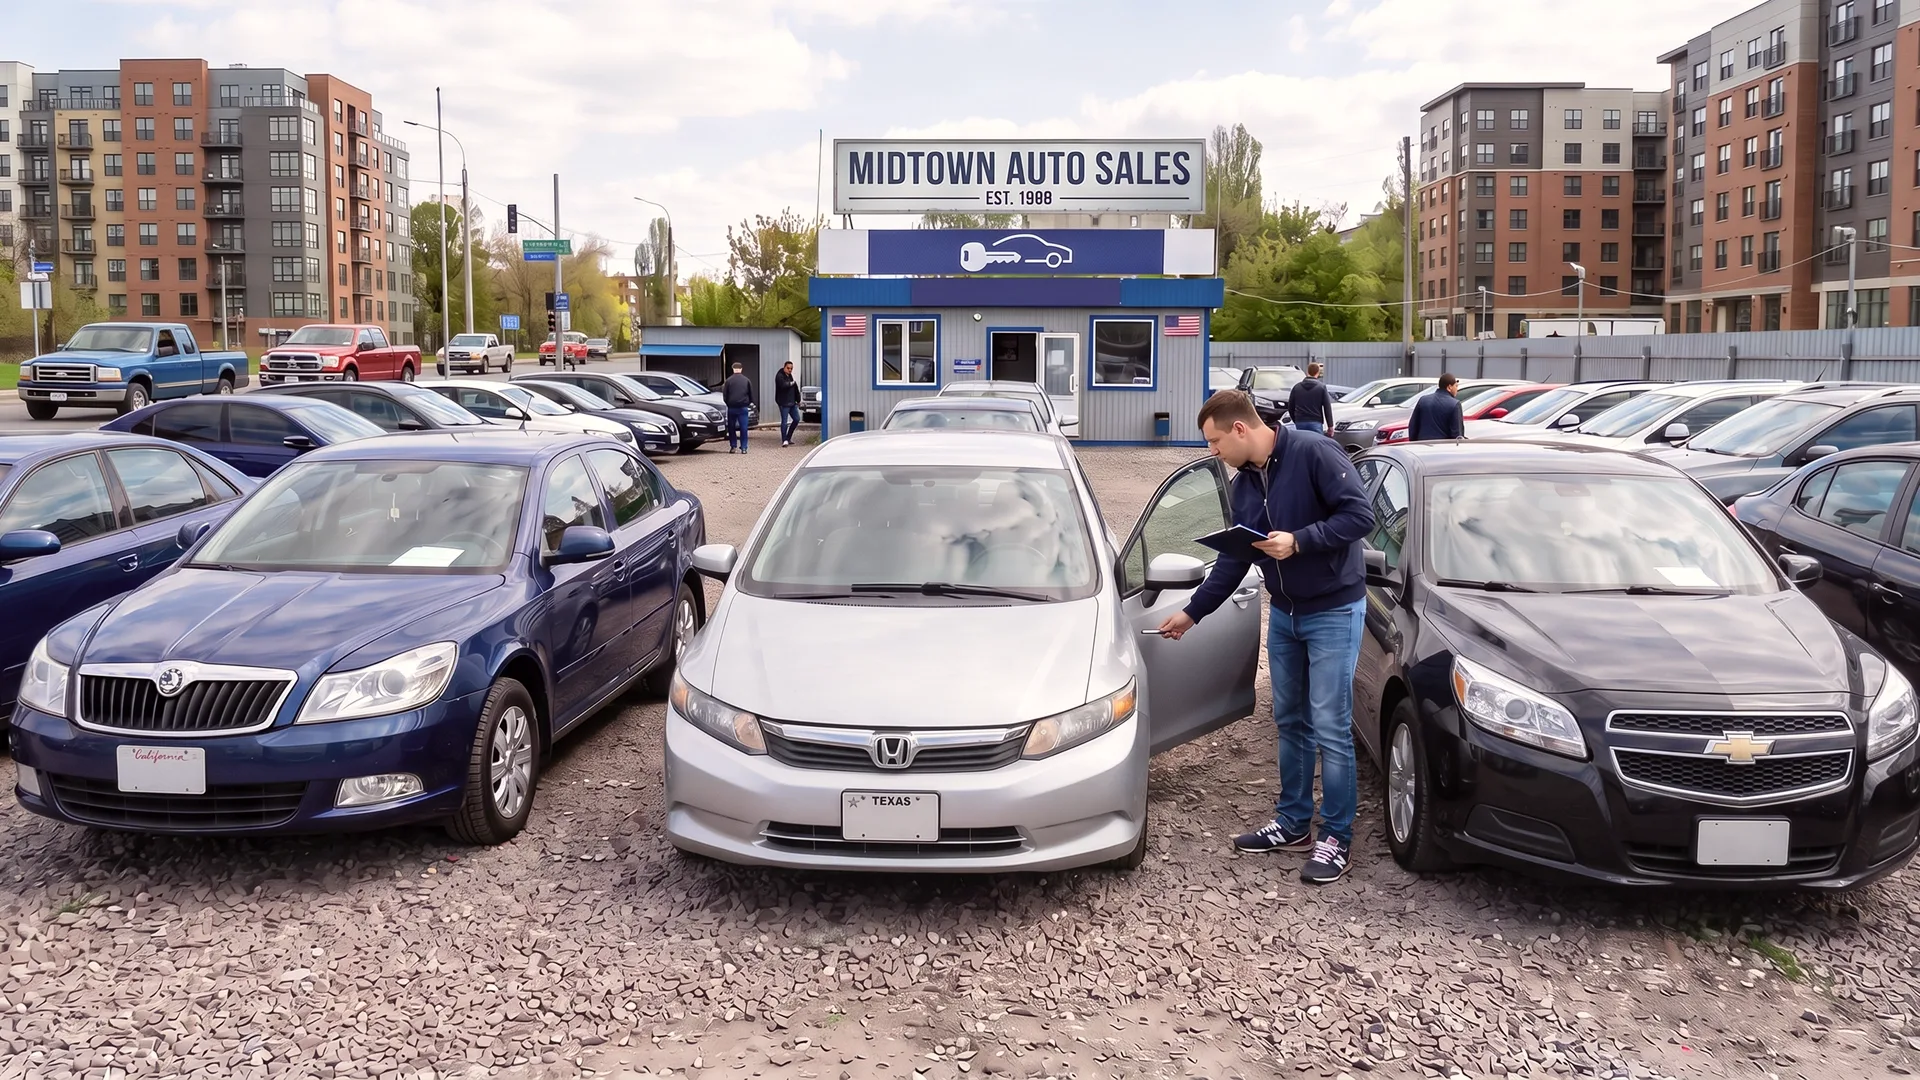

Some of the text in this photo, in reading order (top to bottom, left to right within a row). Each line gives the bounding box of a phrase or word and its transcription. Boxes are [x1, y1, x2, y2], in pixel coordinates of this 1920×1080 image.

[849, 151, 1191, 185] MIDTOWN AUTO SALES
[986, 190, 1052, 205] EST. 1988
[135, 749, 188, 763] California
[871, 796, 911, 806] TEXAS
[1267, 831, 1287, 846] N
